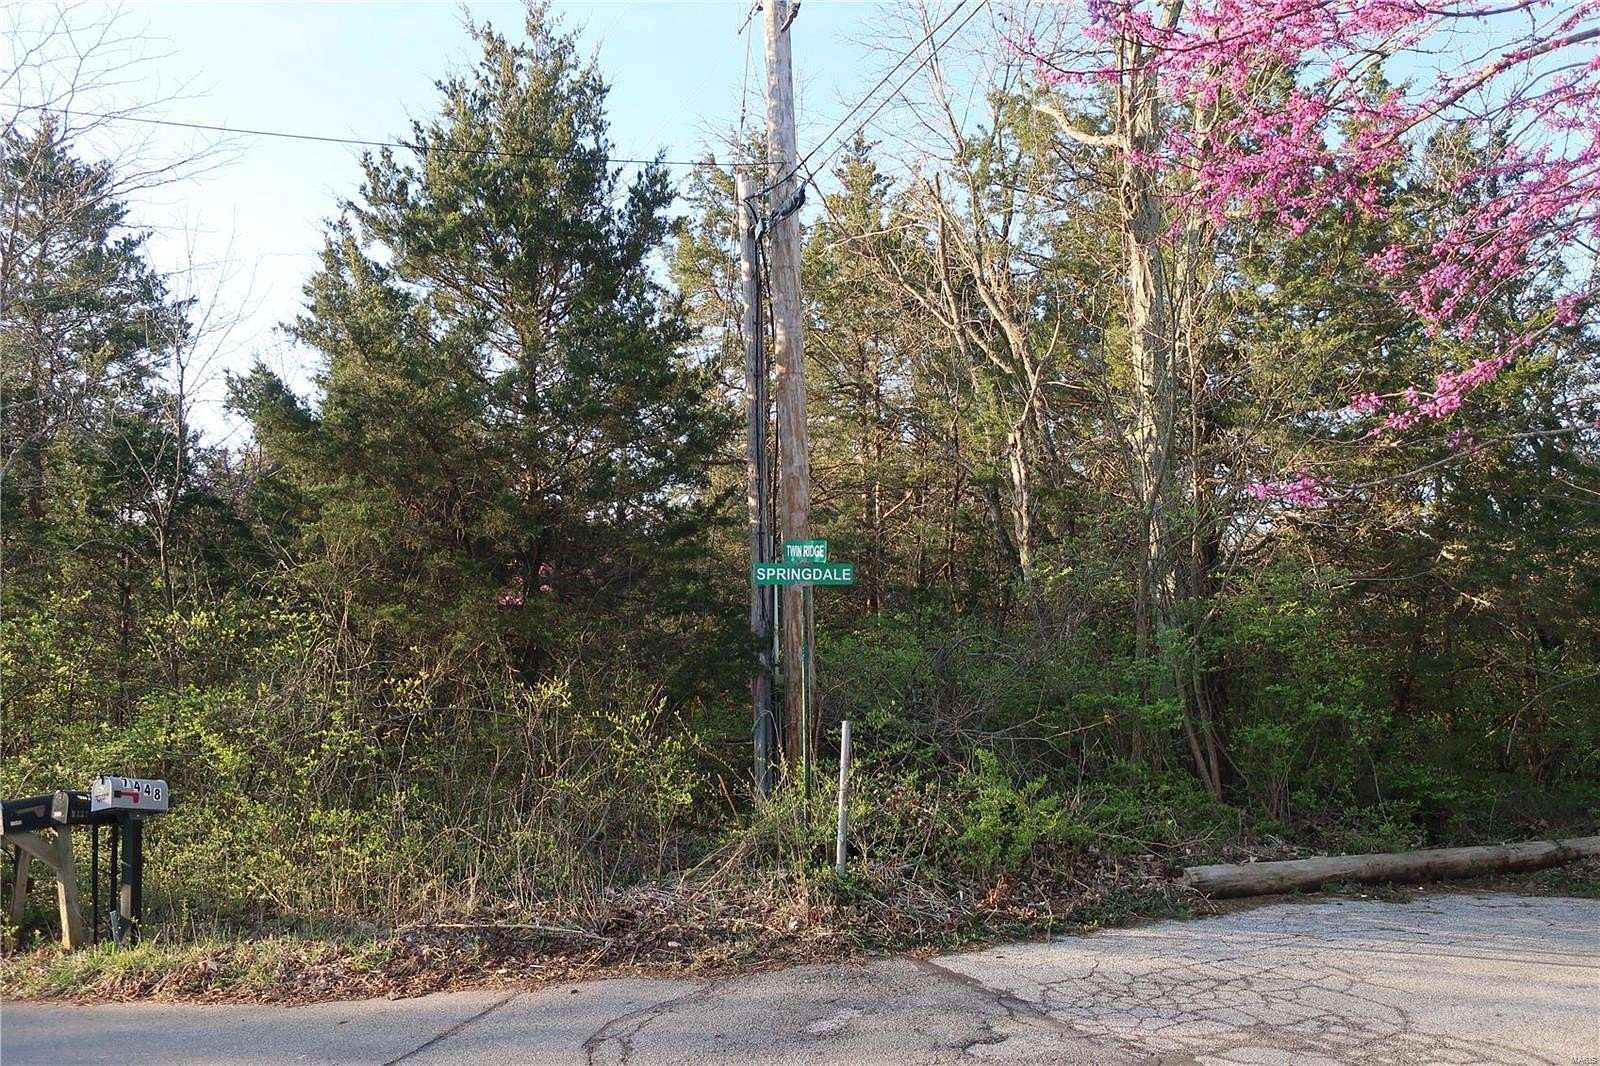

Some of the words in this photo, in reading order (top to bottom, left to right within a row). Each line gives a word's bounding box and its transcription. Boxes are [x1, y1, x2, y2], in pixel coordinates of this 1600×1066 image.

[786, 545, 802, 557] TWIN
[803, 545, 824, 557] RIDGE
[756, 568, 851, 580] SPRINGDALE
